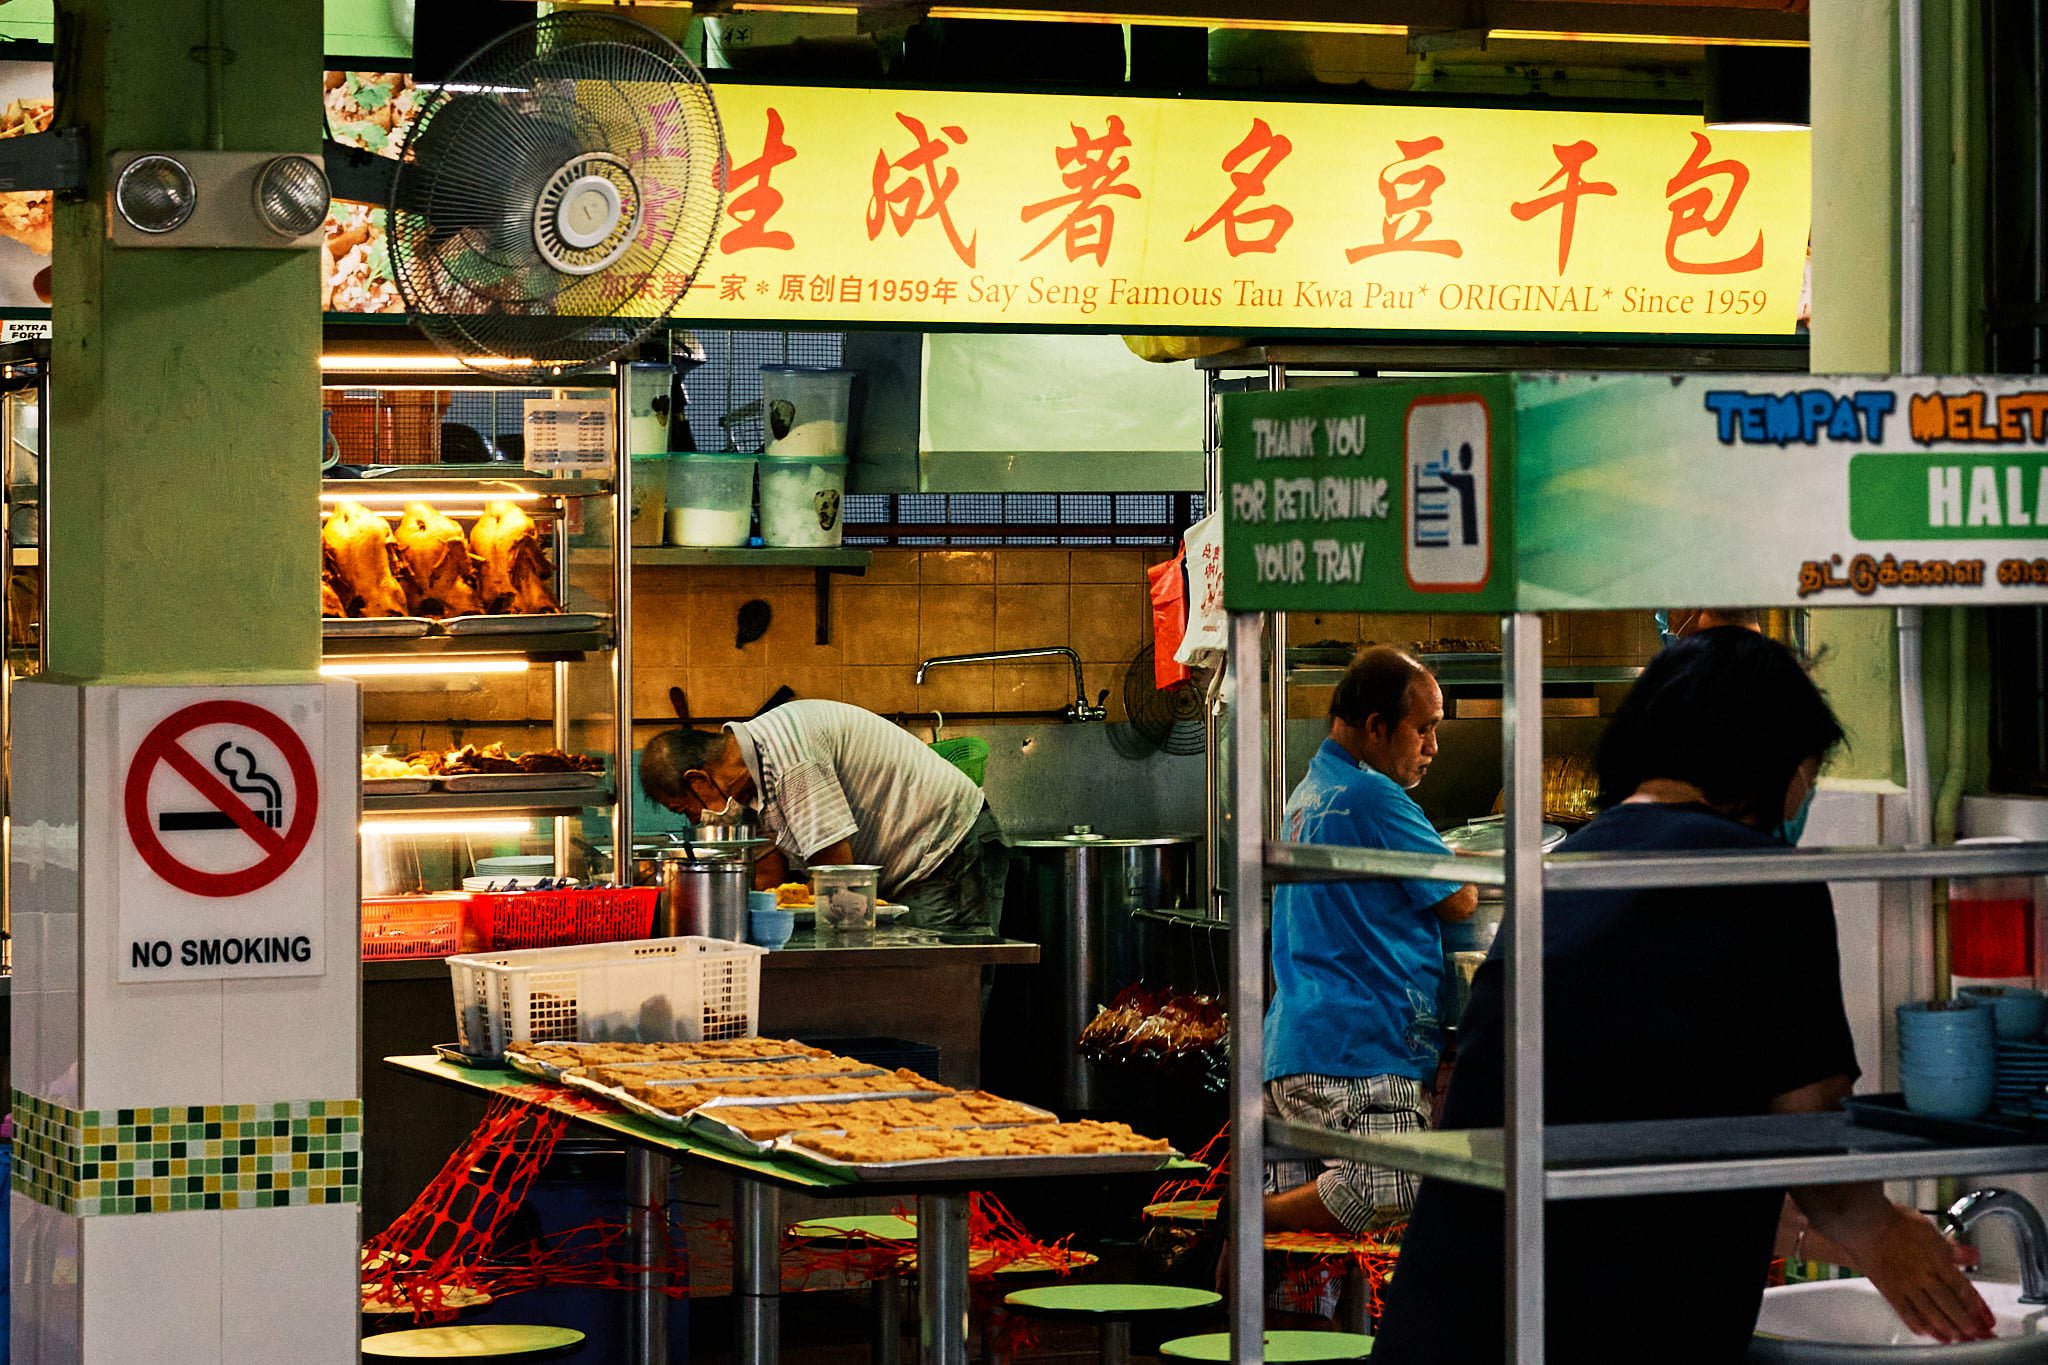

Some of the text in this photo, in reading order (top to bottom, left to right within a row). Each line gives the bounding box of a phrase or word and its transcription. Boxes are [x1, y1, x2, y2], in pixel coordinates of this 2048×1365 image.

[778, 274, 957, 304] 原创自1959年
[968, 275, 1019, 312] Say
[1027, 276, 1099, 314] Seng
[1107, 278, 1222, 307] Famous
[1234, 280, 1283, 308] Tau
[1293, 281, 1353, 309] Kwa
[1622, 286, 1694, 314] Since
[1704, 289, 1768, 315] 1959
[1252, 414, 1367, 459] THANK YOU
[1705, 390, 1896, 446] TEMPAT
[1231, 476, 1390, 523] FOR RETURNING
[1254, 540, 1306, 583] YOUR
[1313, 539, 1366, 583] TRAY
[132, 936, 312, 968] NO SMOKING
